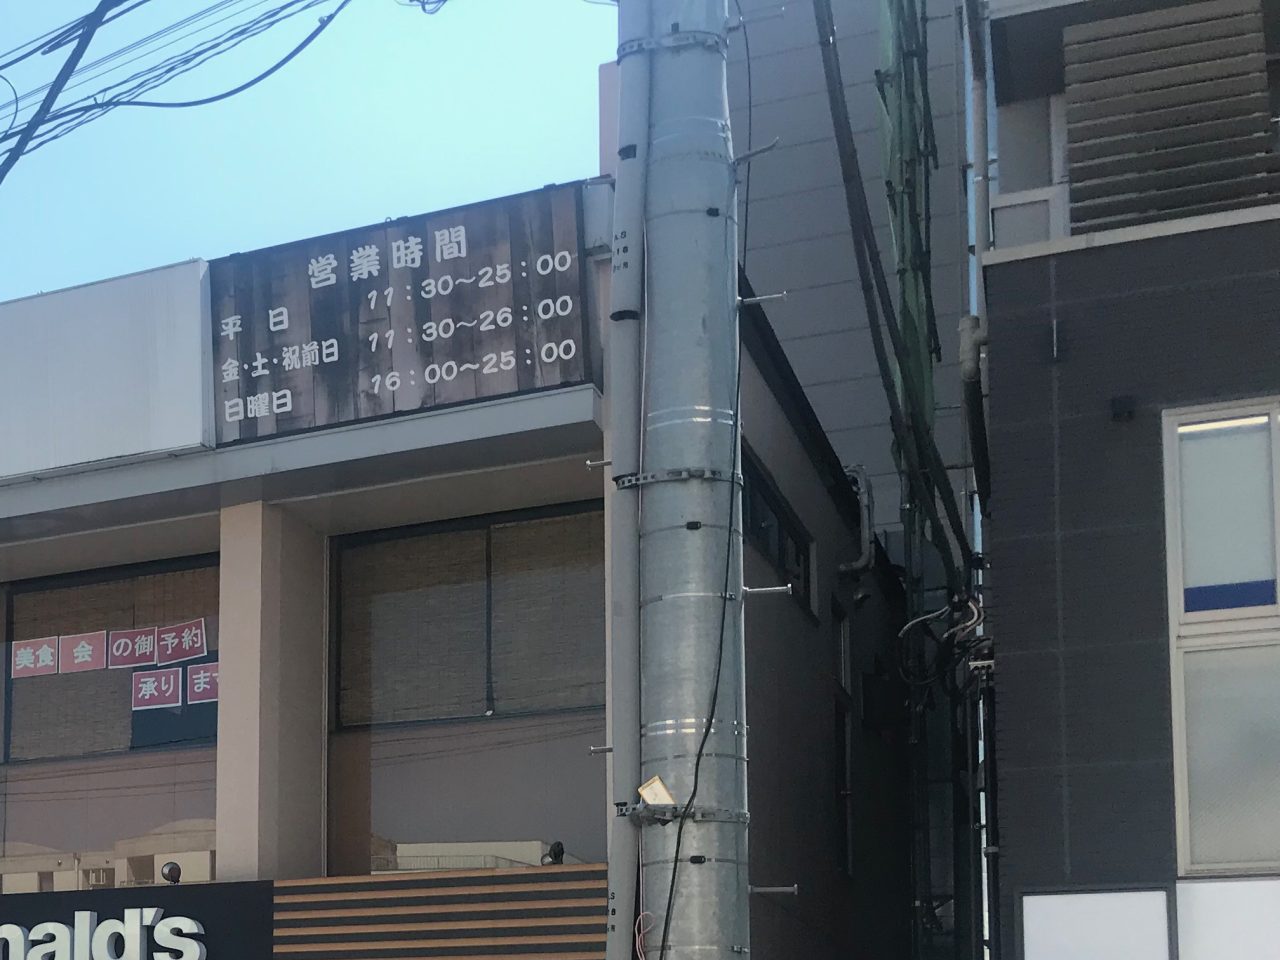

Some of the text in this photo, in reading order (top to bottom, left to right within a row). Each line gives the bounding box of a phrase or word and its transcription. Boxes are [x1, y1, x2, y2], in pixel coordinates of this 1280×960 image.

[308, 225, 467, 289] 営業時間
[224, 388, 293, 423] 日曜日
[138, 670, 218, 700] 承りま
